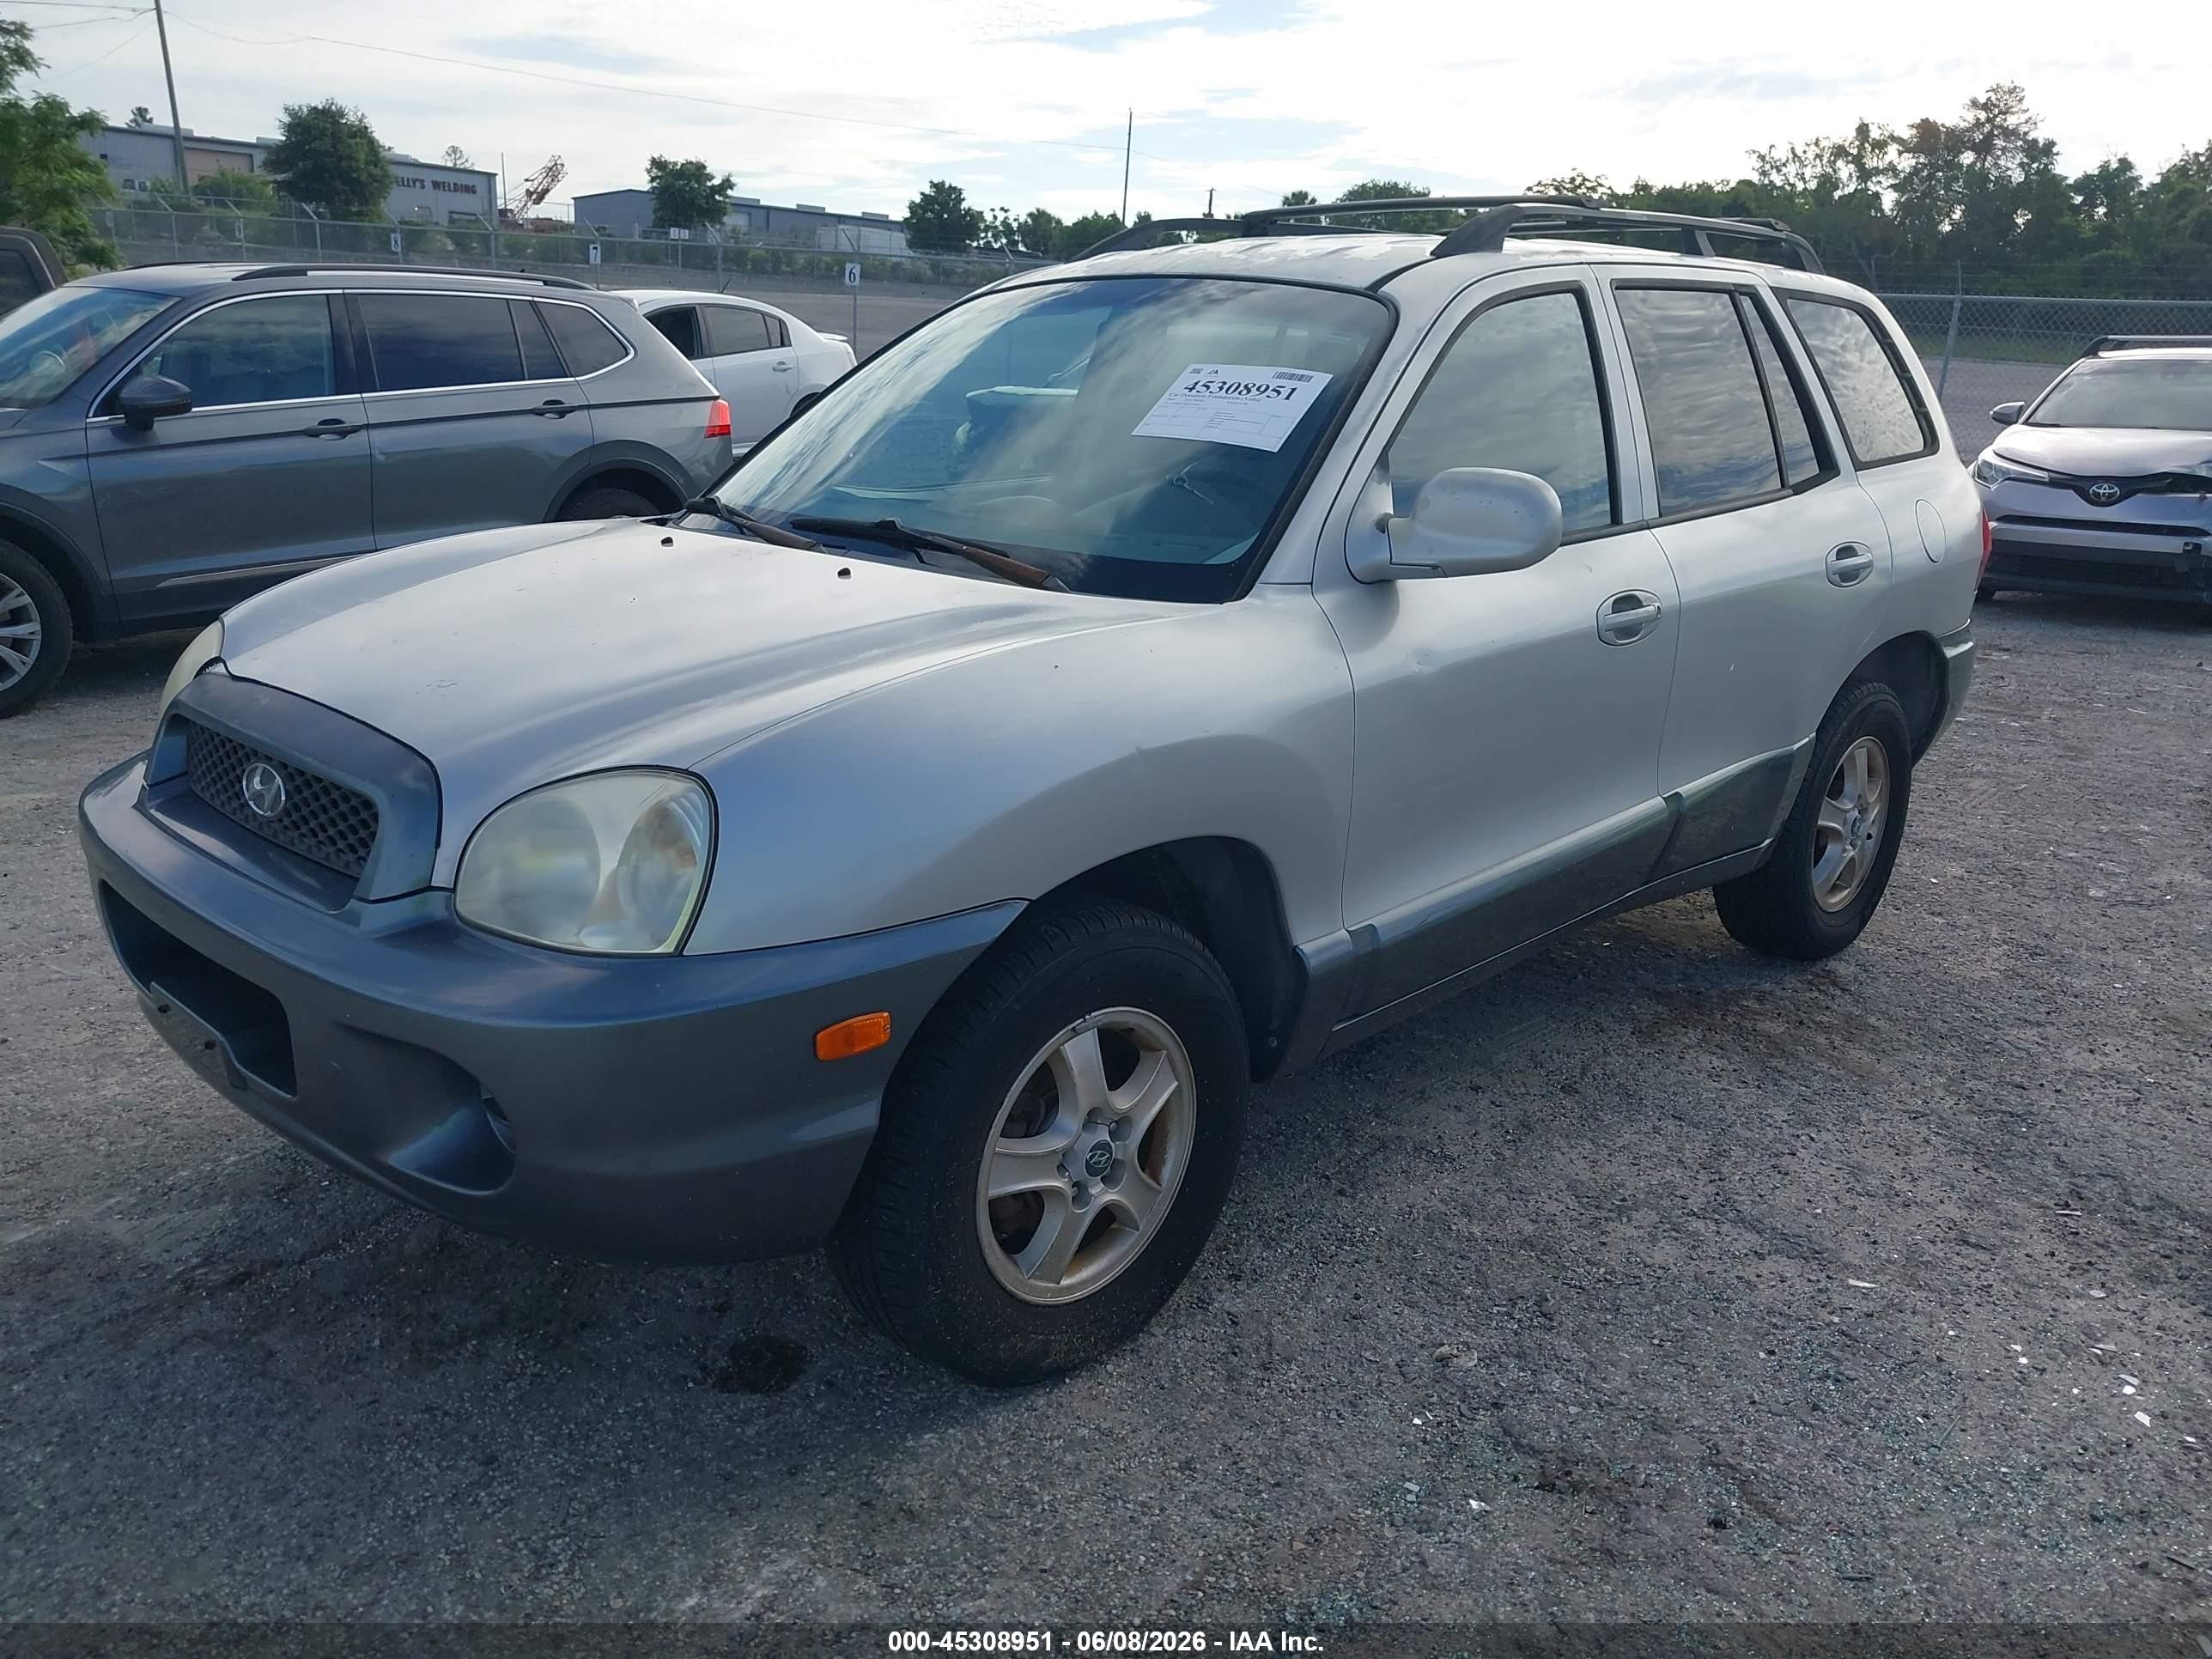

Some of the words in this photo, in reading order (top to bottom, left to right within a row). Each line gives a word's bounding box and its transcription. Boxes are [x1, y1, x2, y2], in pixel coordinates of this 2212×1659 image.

[396, 176, 426, 190] ELLY'S
[431, 179, 477, 195] WELDING
[592, 246, 599, 261] 7
[848, 266, 856, 283] 6
[1183, 379, 1298, 401] 45308951
